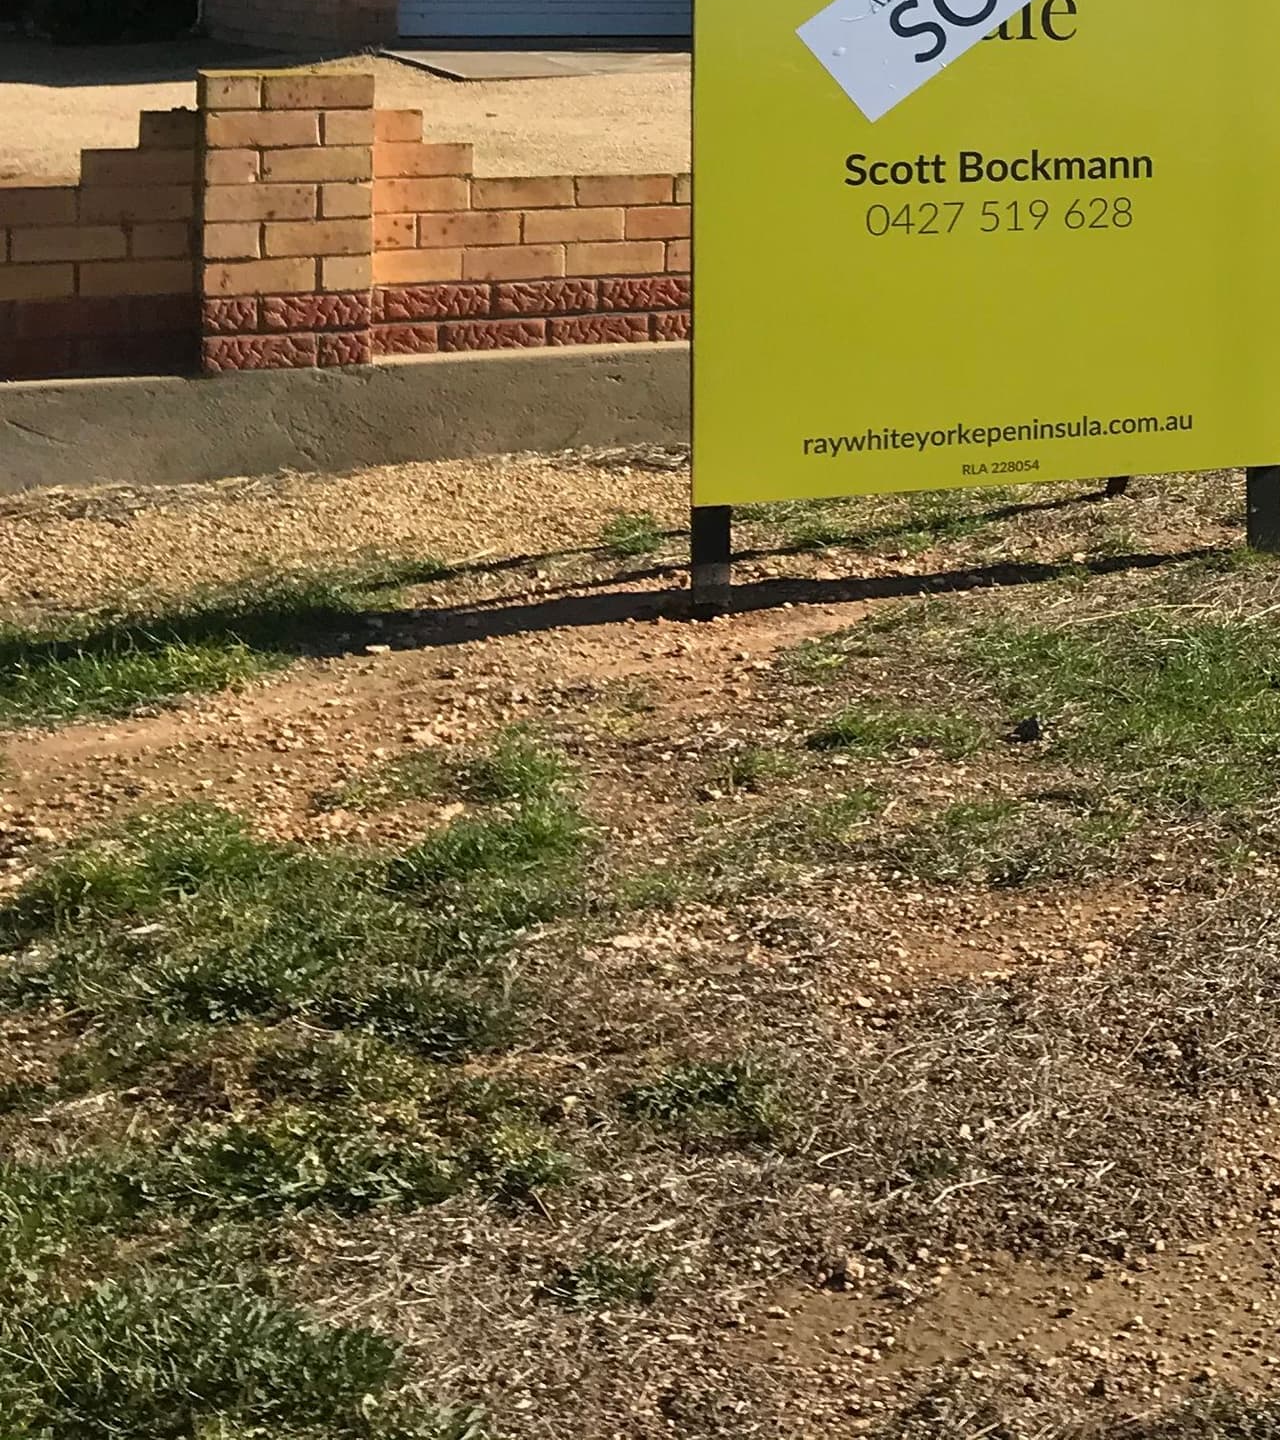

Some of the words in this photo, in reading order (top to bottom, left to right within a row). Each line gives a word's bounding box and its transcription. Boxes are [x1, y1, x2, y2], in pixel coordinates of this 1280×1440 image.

[844, 153, 946, 186] Scott
[959, 149, 1153, 183] Bockmann
[866, 202, 965, 236] 0427
[979, 200, 1049, 232] 519
[1064, 197, 1133, 229] 628
[803, 414, 1193, 458] raywhiteyorkepeninsula.com.au
[962, 463, 988, 476] RLA
[991, 459, 1040, 474] 228054
